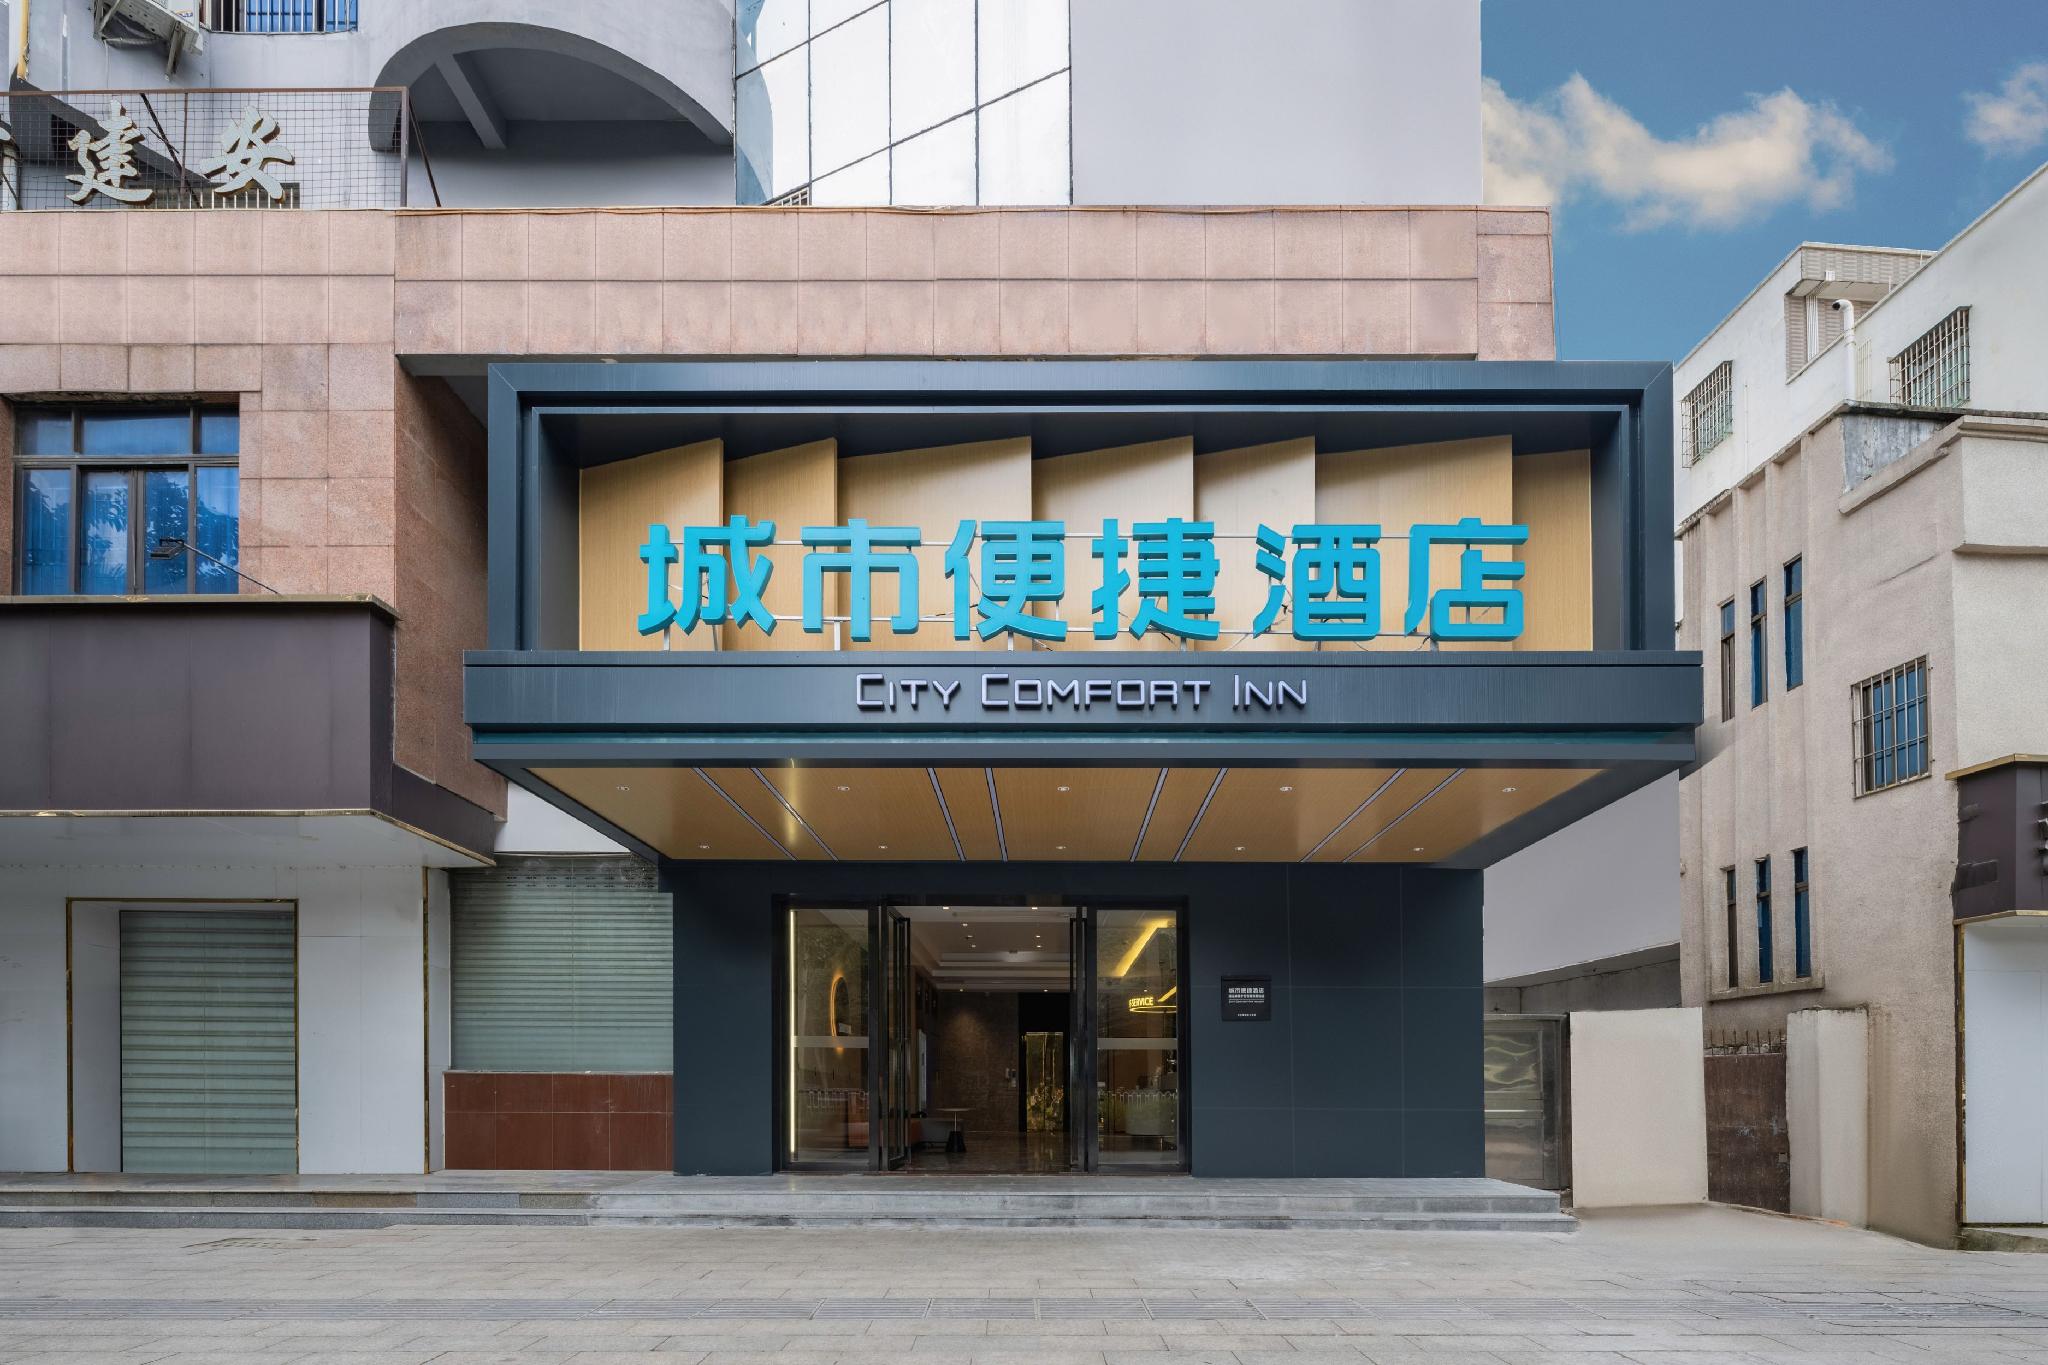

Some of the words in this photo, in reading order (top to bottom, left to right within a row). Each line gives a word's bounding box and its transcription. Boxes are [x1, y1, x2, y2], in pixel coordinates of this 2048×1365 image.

[0, 99, 296, 205] 建安
[637, 514, 1529, 642] 城市便捷酒店
[856, 673, 960, 711] CITY
[981, 673, 1211, 711] COMFORT
[1233, 673, 1307, 711] INN
